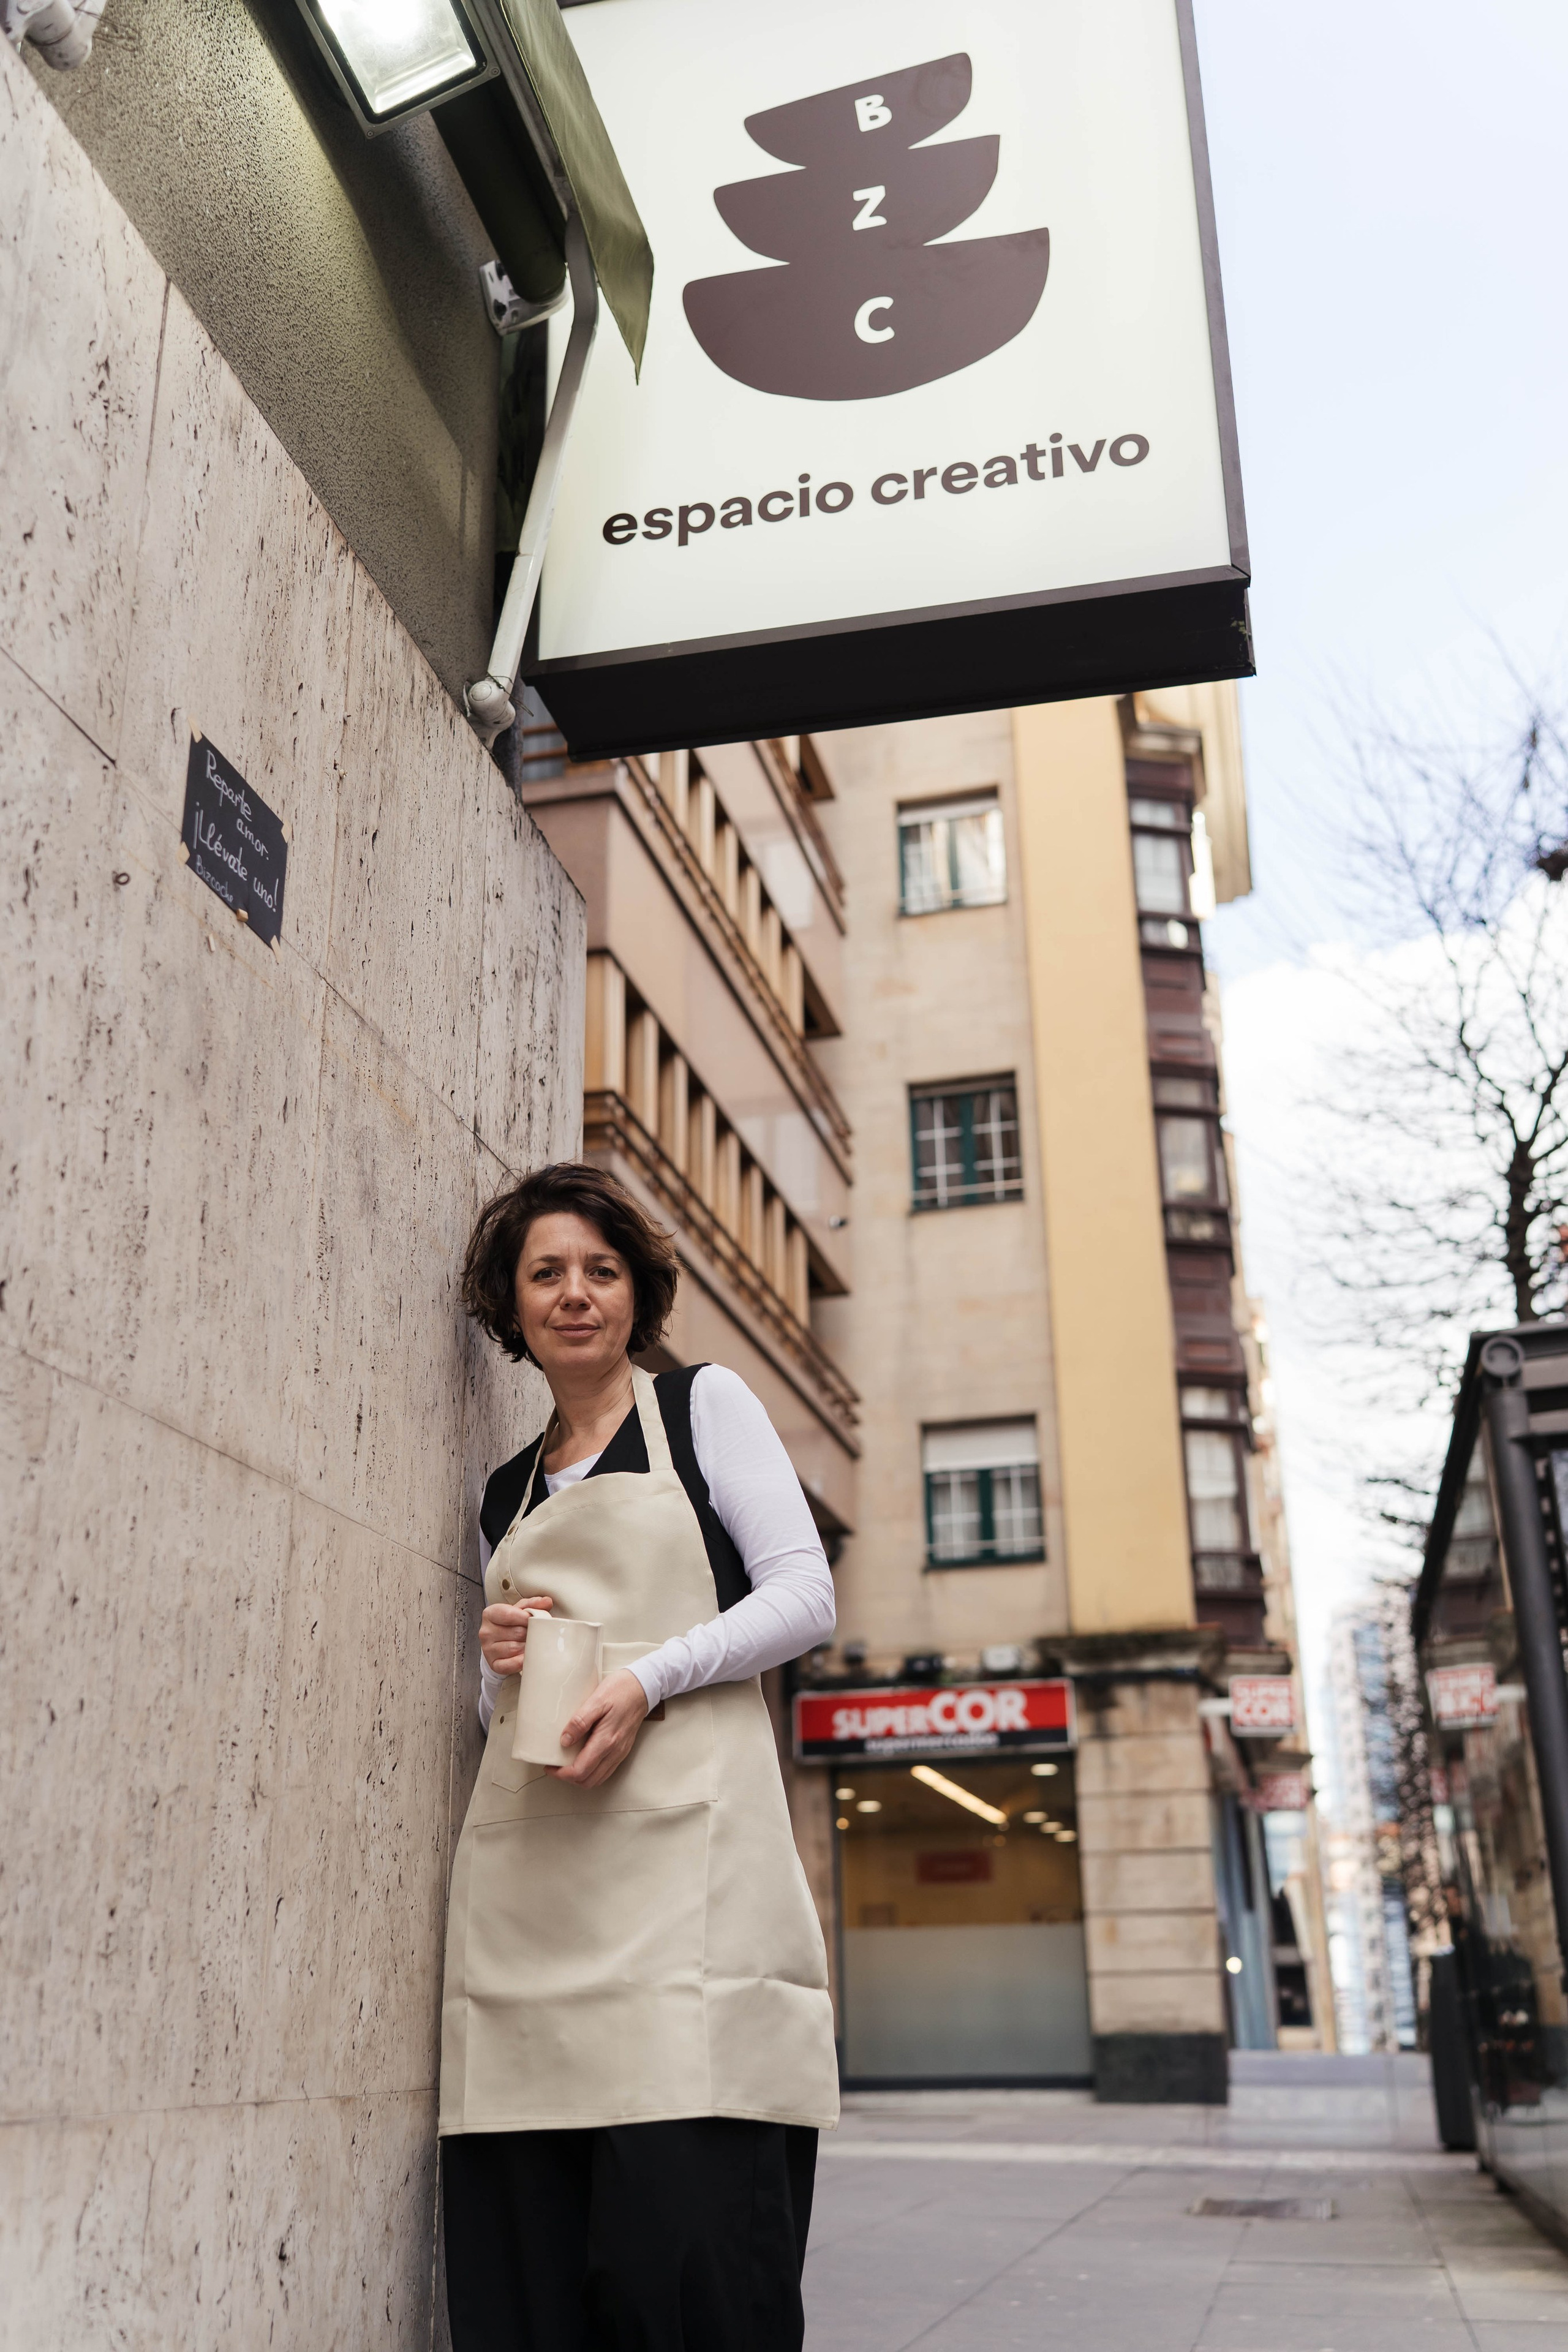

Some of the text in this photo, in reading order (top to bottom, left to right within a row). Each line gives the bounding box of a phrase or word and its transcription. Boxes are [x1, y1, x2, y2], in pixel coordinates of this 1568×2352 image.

[854, 94, 892, 132] B
[852, 185, 888, 231] Z
[854, 296, 895, 344] C
[602, 432, 1150, 547] espacio creativo
[206, 750, 252, 822] Reparte
[236, 818, 269, 861] amor.
[253, 876, 279, 913] uno!
